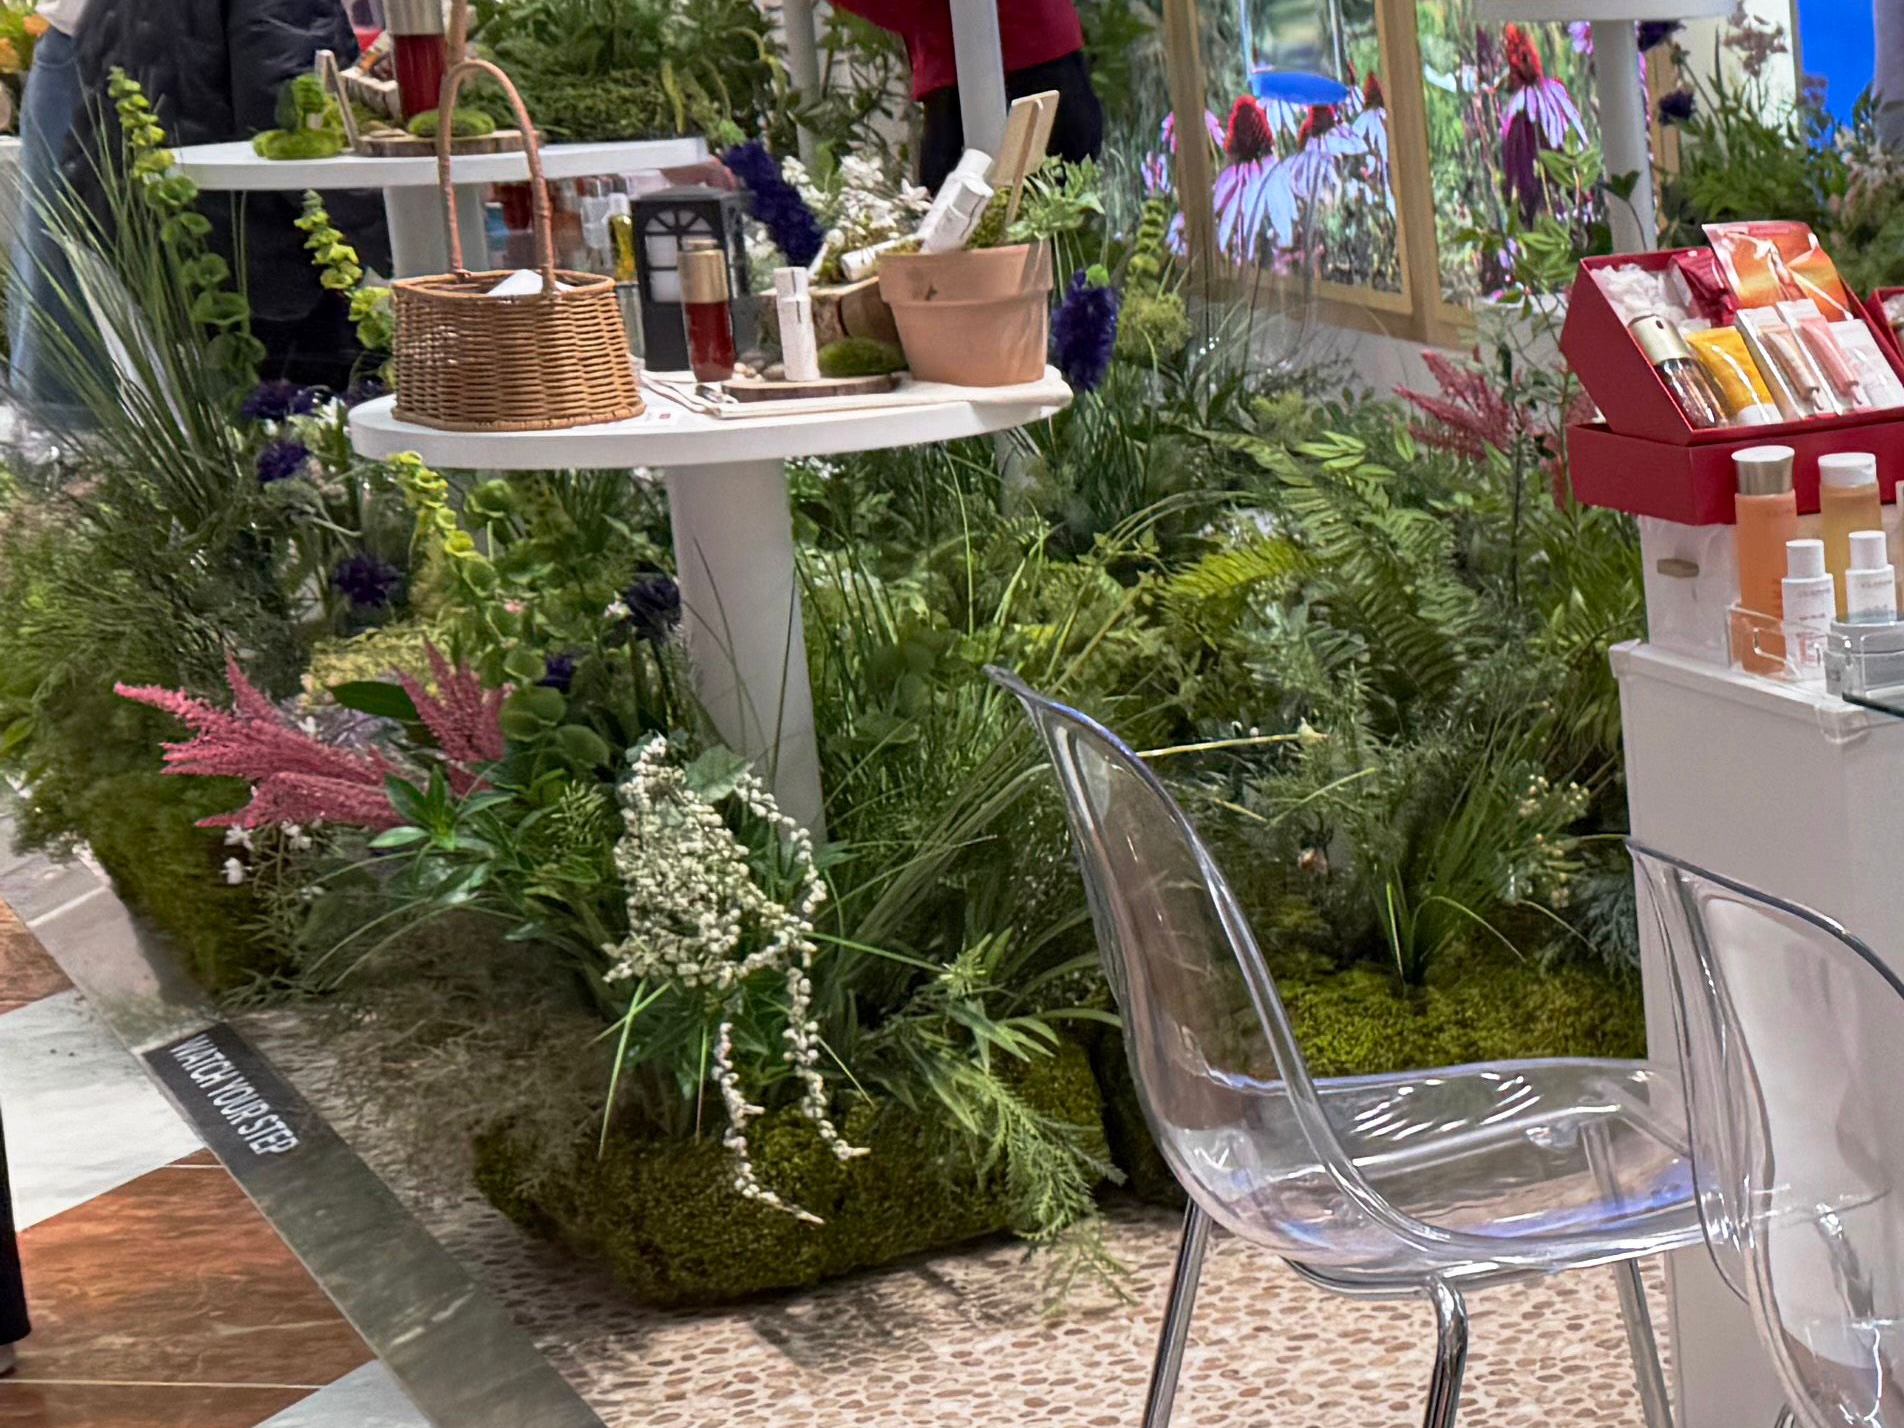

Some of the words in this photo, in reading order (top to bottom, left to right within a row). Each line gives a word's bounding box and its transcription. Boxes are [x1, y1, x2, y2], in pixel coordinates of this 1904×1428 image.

[170, 1033, 240, 1089] WATCH
[206, 1075, 272, 1126] YOUR
[237, 1114, 300, 1155] STEP
